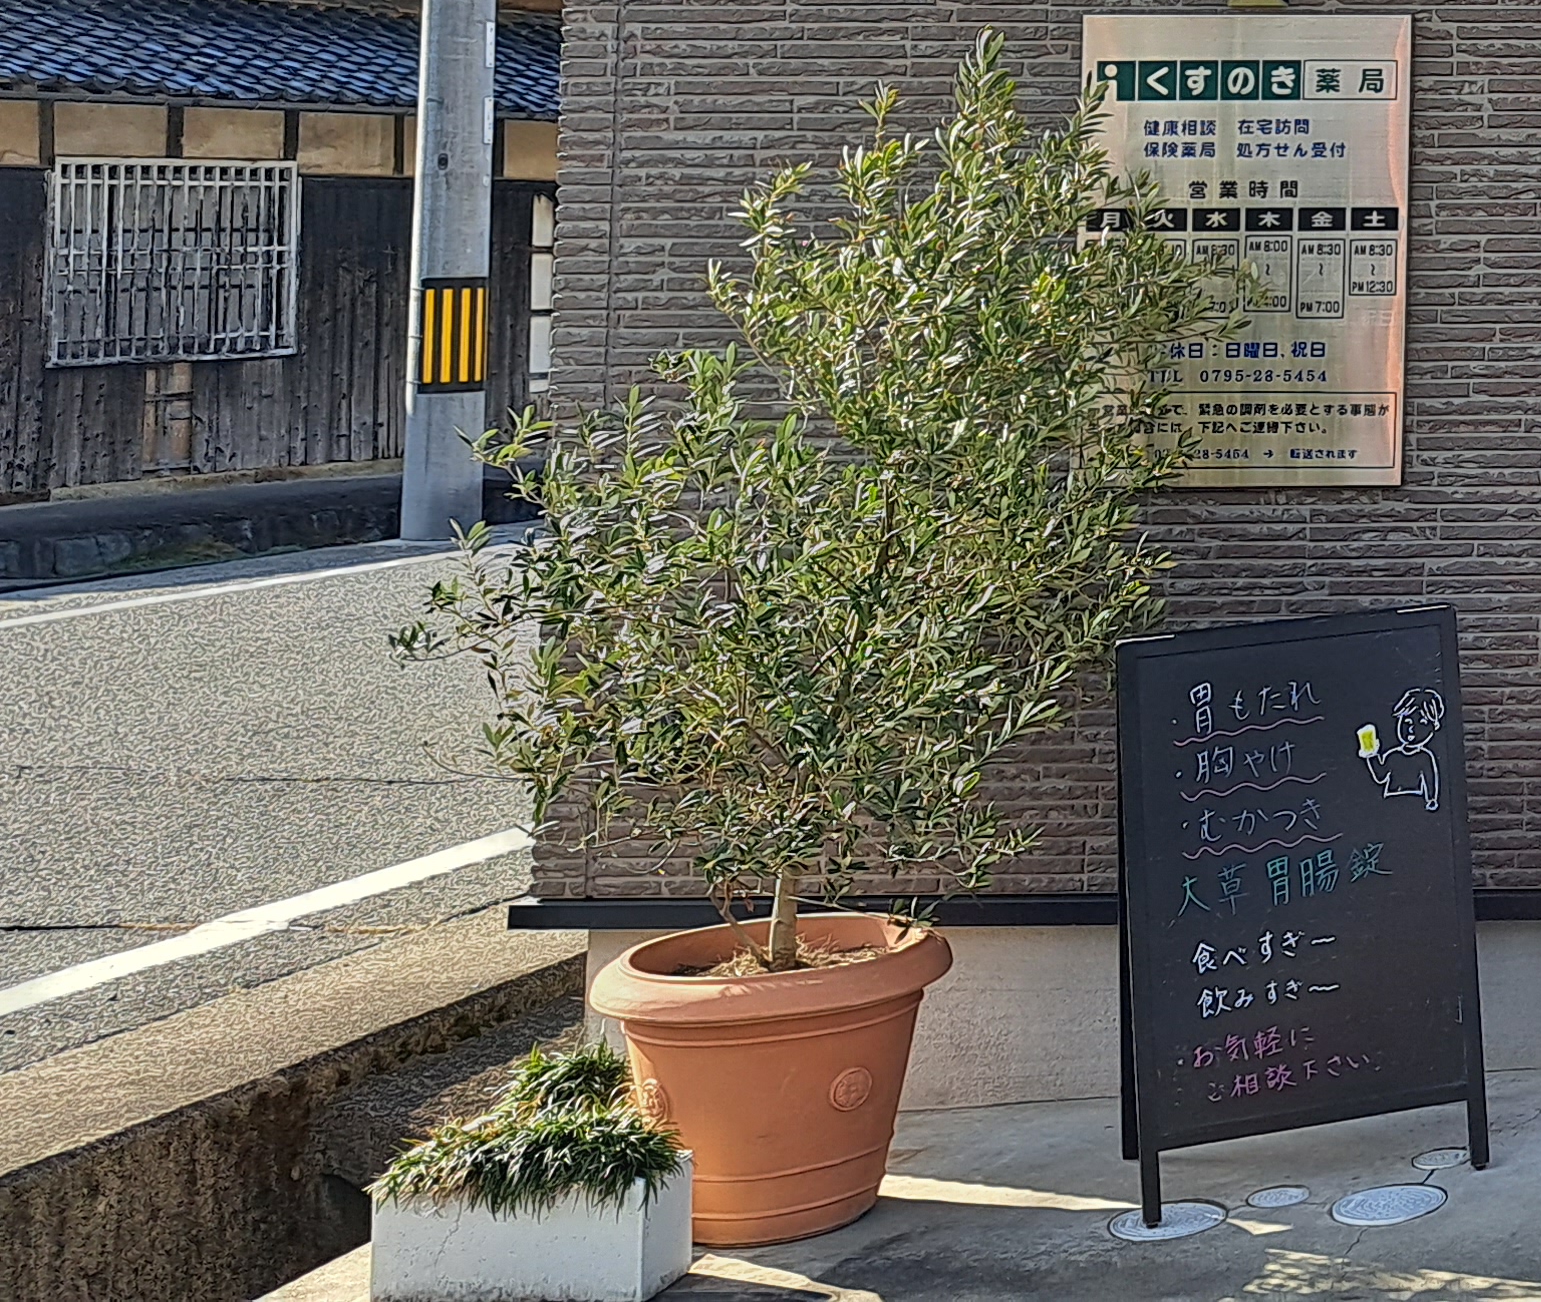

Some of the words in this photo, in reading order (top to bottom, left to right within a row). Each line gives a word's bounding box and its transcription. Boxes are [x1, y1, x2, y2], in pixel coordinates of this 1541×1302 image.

[1143, 119, 1217, 137] 健康相談
[1237, 118, 1310, 136] 在宅訪問
[1143, 141, 1216, 159] 保険薬局
[1236, 141, 1346, 159] 処方せん受付
[1188, 180, 1299, 200] 営業時間
[1100, 212, 1121, 228] 月
[1205, 212, 1228, 228] 水
[1257, 212, 1281, 228] 木
[1310, 211, 1334, 228] 金
[1363, 212, 1387, 228] 土
[1196, 245, 1209, 255] AM
[1249, 241, 1262, 251] AM
[1263, 240, 1288, 252] 8:00
[1301, 244, 1315, 255] AM
[1317, 243, 1341, 256] 8:30
[1354, 244, 1366, 255] AM
[1368, 243, 1393, 256] 8:30
[1352, 282, 1365, 292] PM
[1365, 281, 1393, 293] 12:30
[1300, 302, 1313, 313] PM
[1315, 301, 1340, 313] 7:00
[1177, 842, 1394, 917] 大草胃腸錠
